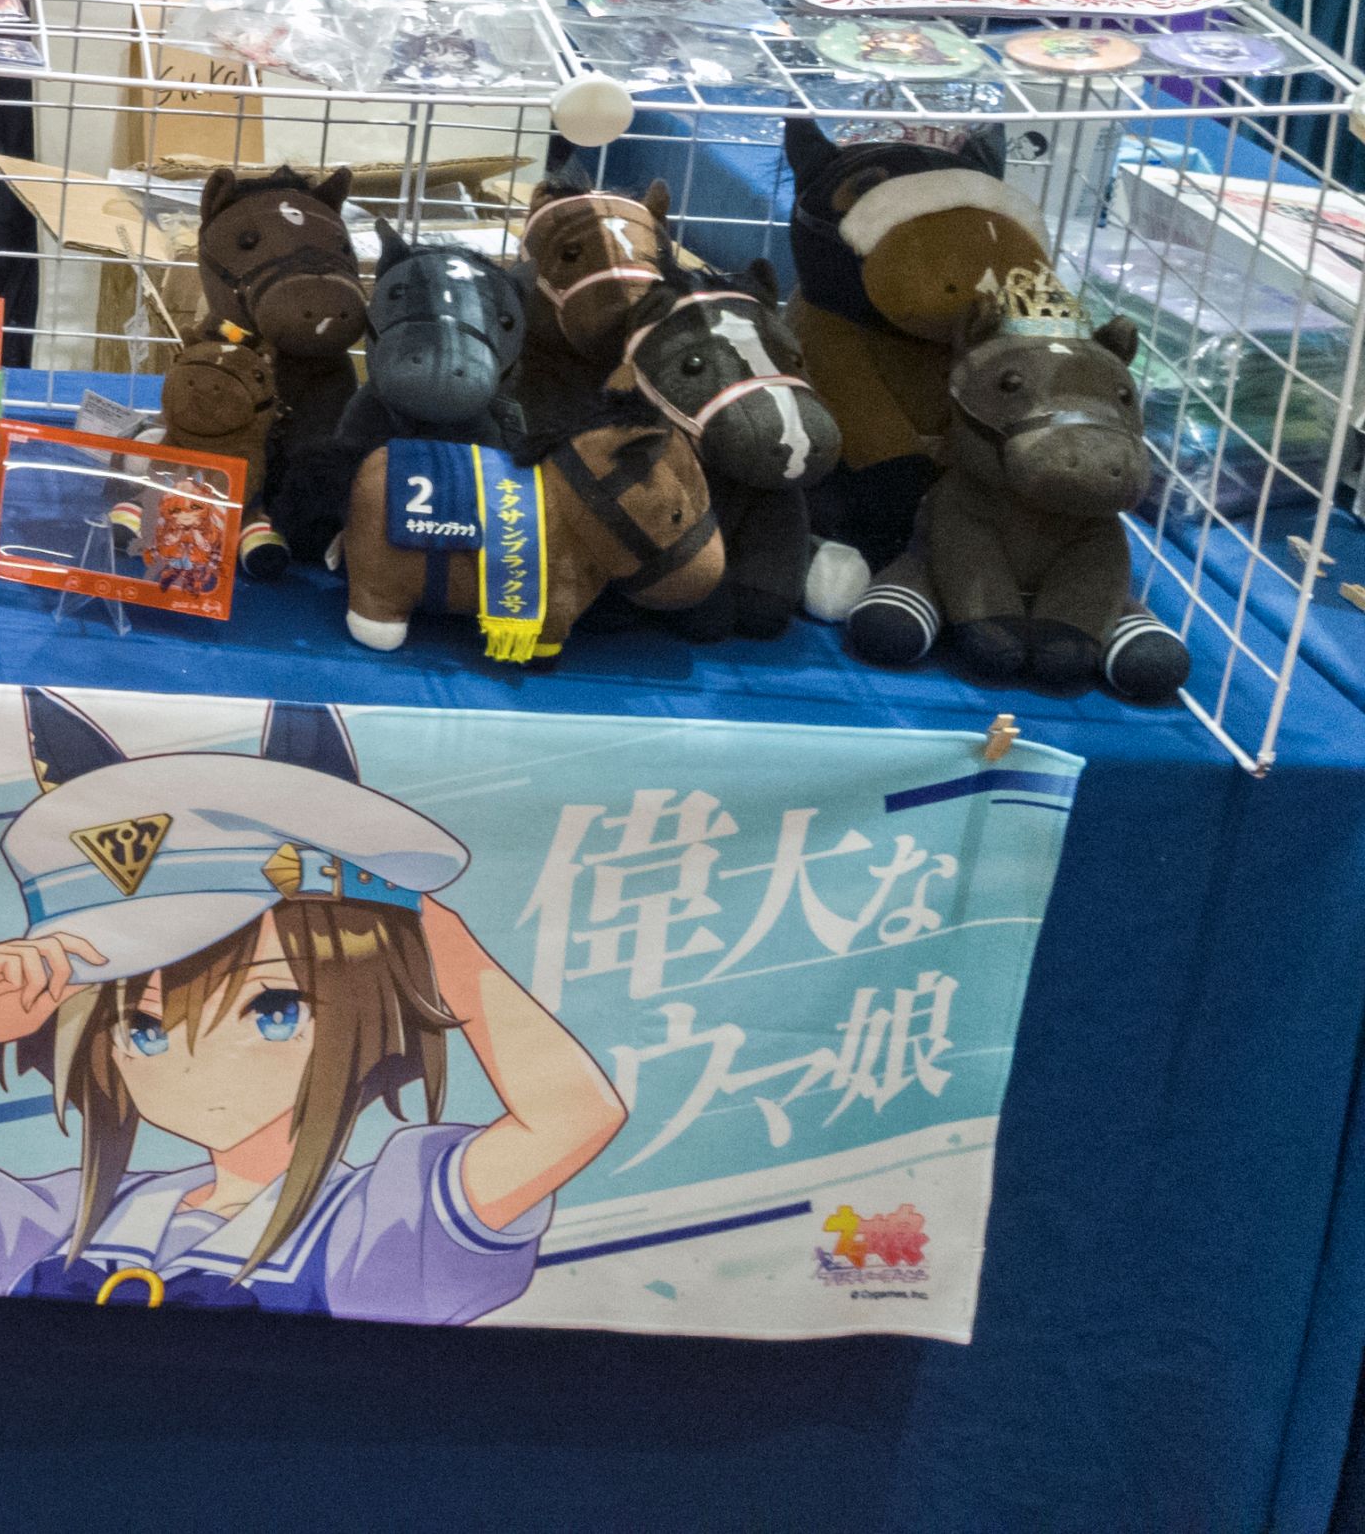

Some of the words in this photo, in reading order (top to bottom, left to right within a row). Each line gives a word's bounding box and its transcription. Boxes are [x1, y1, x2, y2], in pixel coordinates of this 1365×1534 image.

[405, 473, 434, 514] 2
[495, 478, 529, 613] キタサンブラック号
[514, 788, 959, 1014] 偉大な
[606, 970, 959, 1178] ウマ娘
